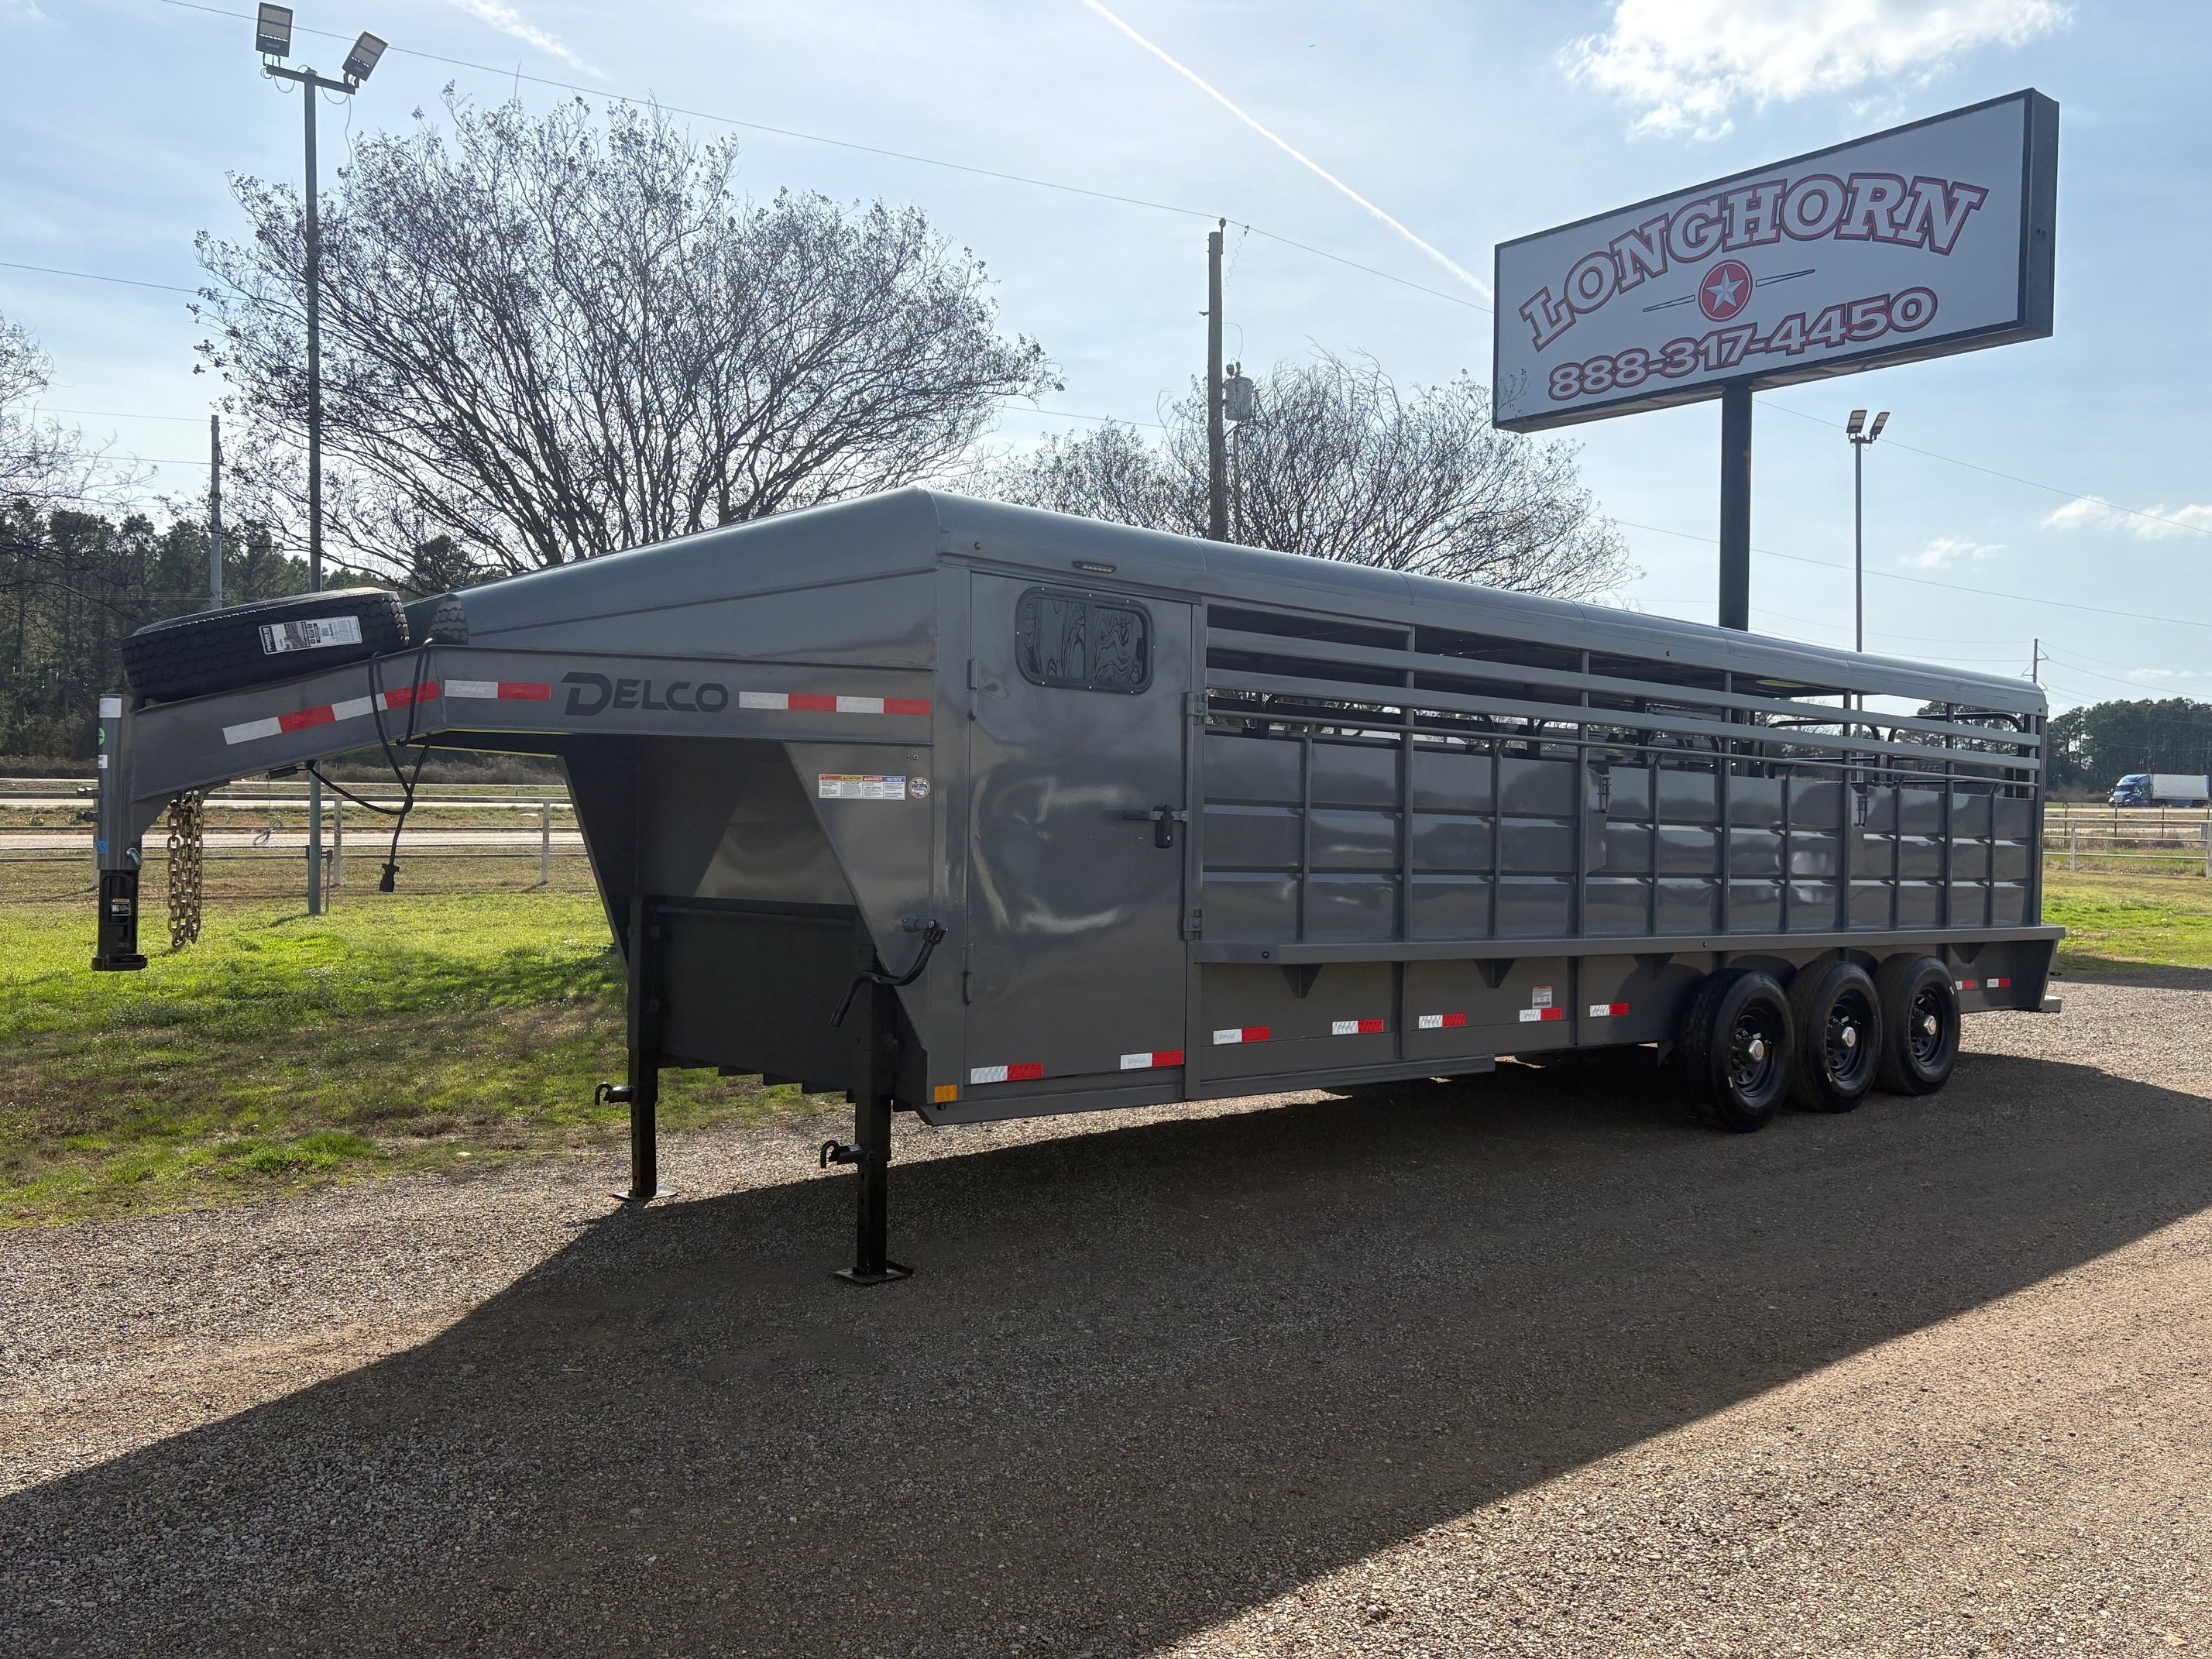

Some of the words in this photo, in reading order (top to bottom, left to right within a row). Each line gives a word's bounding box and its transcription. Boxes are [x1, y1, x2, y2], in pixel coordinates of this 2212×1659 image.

[1519, 172, 1990, 352] LONGHORN
[1549, 287, 1938, 401] 888-317-4450
[560, 672, 729, 716] DELCO
